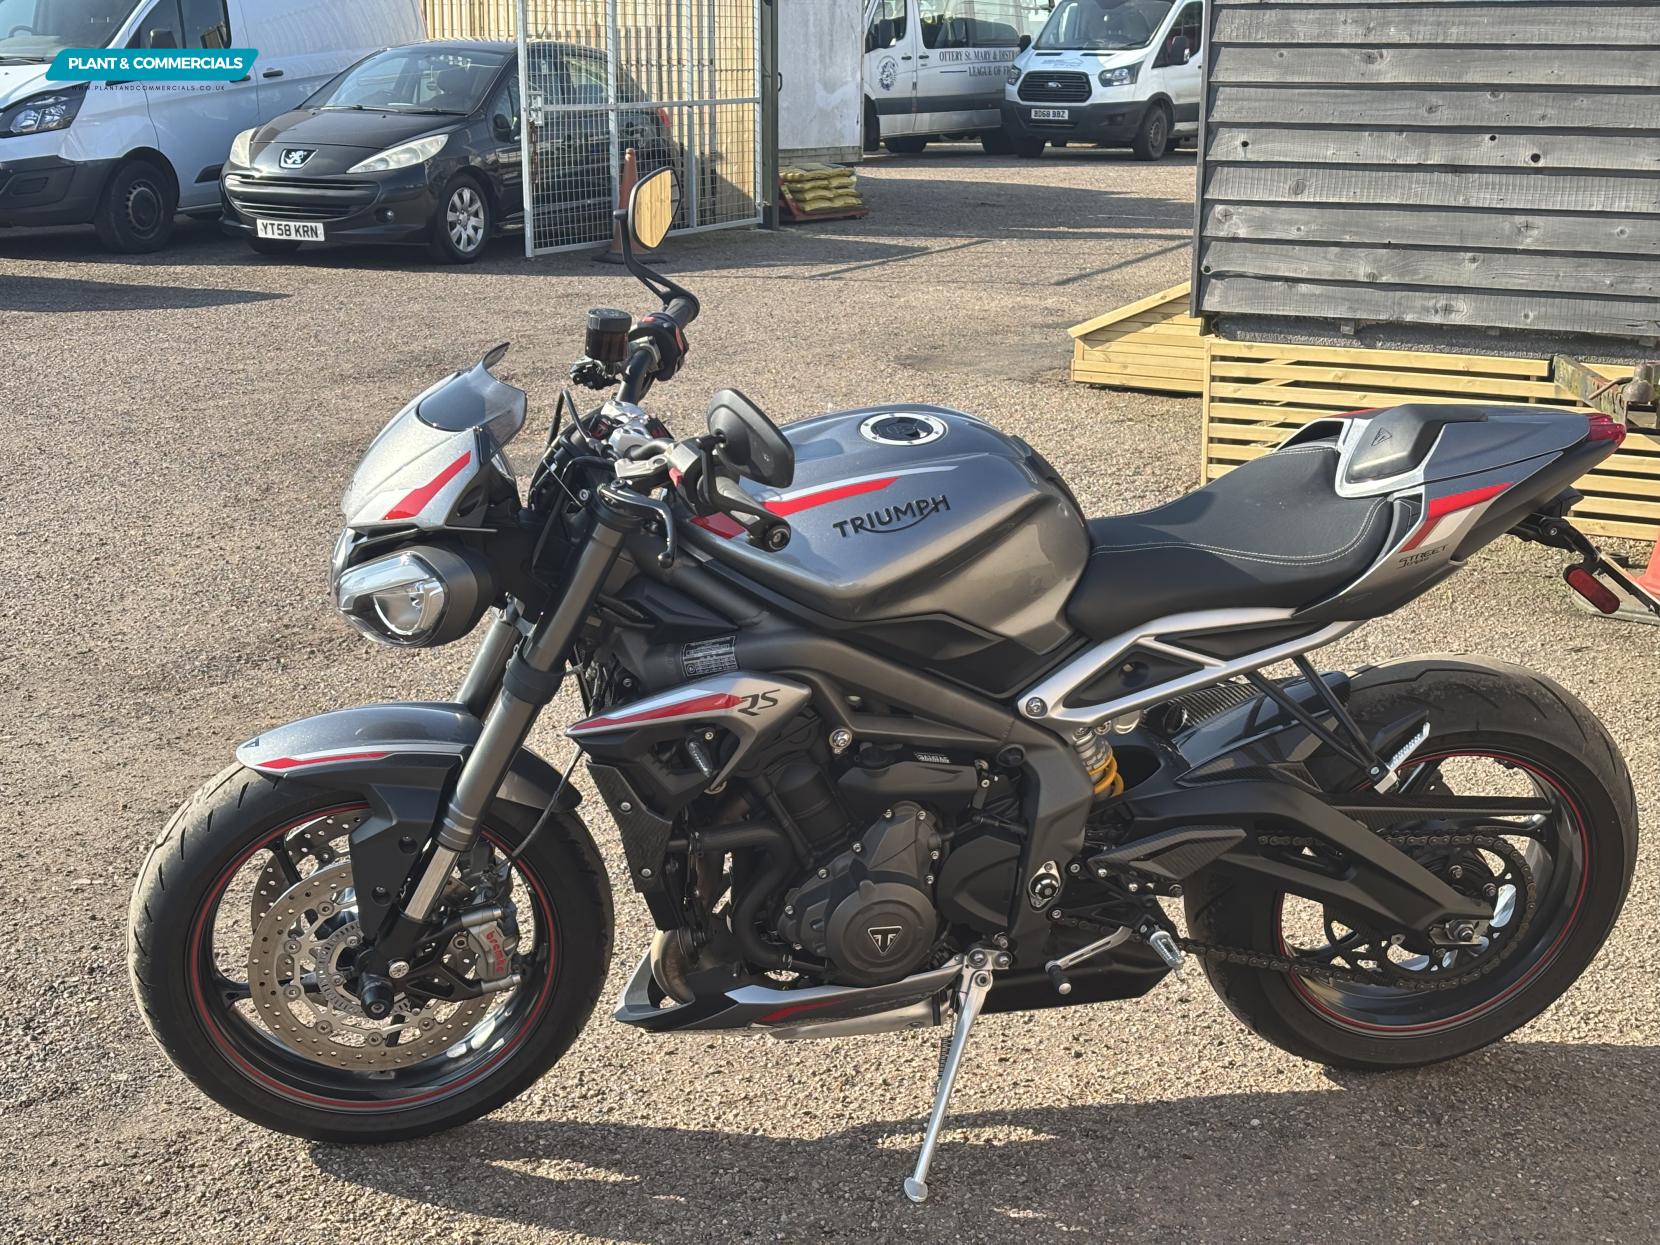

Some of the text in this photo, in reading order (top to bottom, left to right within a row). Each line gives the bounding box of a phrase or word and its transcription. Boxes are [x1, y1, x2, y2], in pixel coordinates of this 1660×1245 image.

[939, 51, 963, 62] OTTERY
[974, 50, 991, 61] MARY
[992, 51, 997, 61] &
[968, 65, 993, 77] LEAGUE
[994, 65, 1001, 76] OF
[261, 221, 319, 239] YT58 KRN
[832, 495, 951, 538] TRIUMPH
